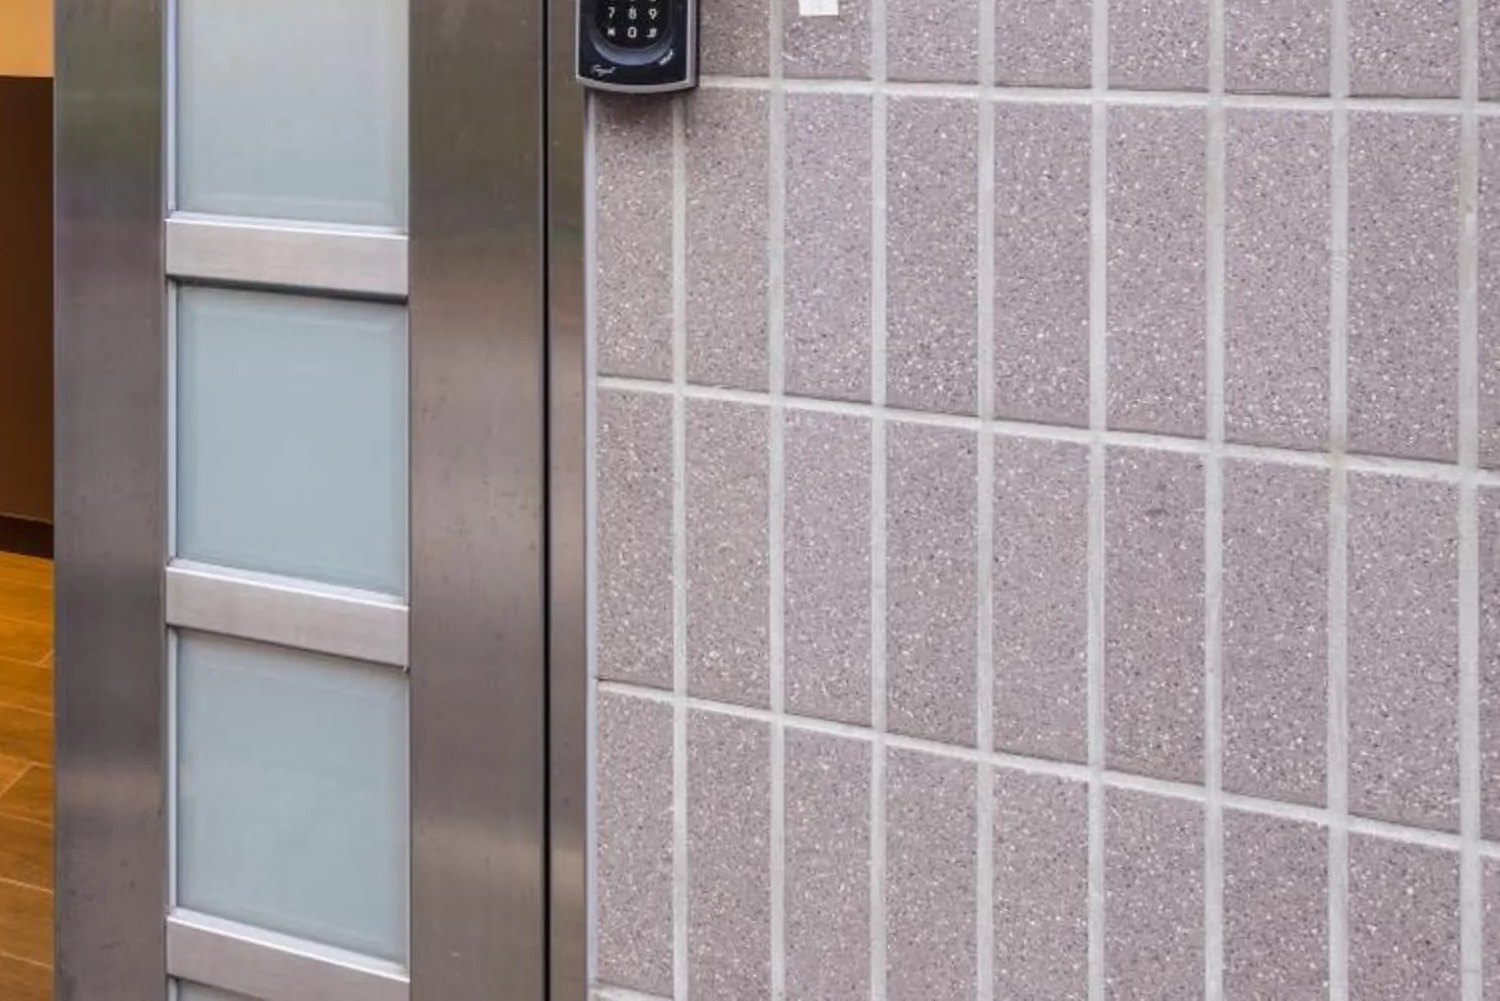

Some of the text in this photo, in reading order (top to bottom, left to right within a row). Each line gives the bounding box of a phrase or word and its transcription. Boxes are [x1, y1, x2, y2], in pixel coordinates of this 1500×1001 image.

[607, 6, 658, 20] 7 8 9
[627, 26, 638, 39] 0
